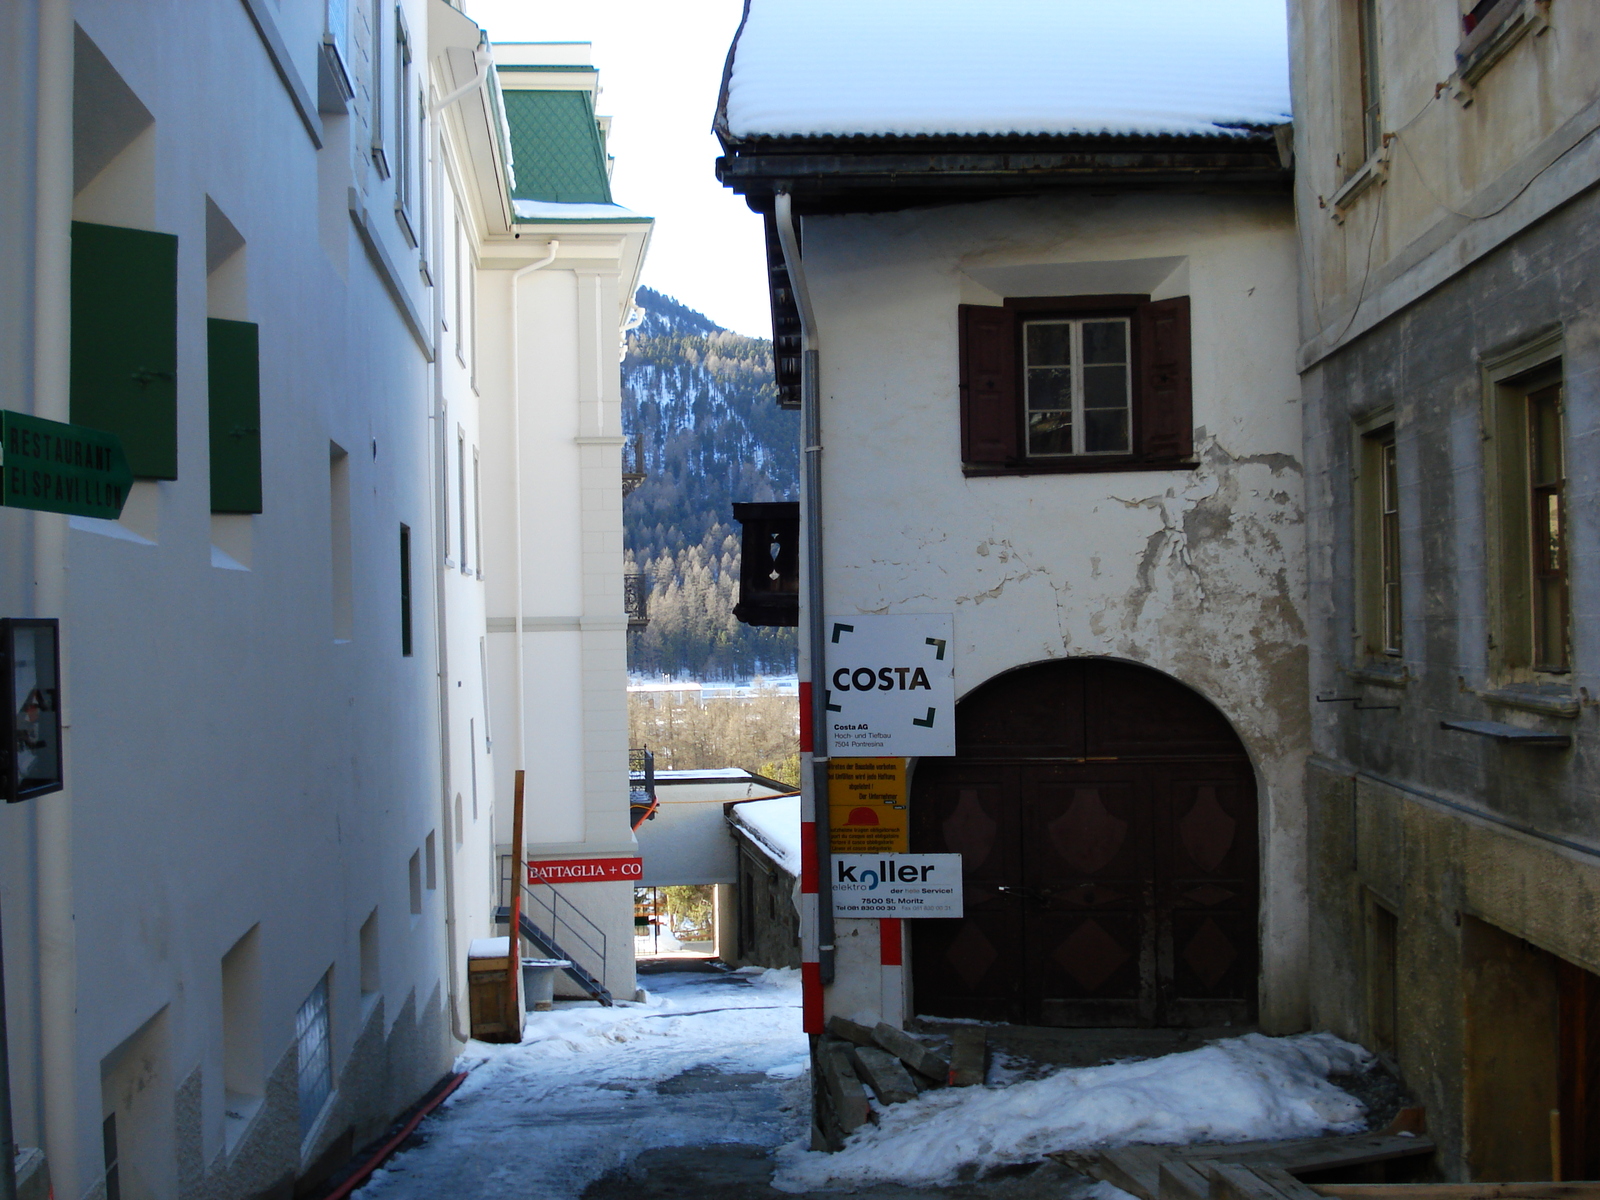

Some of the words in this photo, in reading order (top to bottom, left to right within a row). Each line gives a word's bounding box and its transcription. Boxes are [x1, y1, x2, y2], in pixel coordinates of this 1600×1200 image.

[10, 427, 112, 472] RESTAURANT
[832, 667, 932, 692] COSTA
[834, 723, 856, 731] Costa
[857, 723, 869, 731] AG
[530, 865, 606, 879] BATTAGLIA
[621, 863, 642, 875] CO
[838, 860, 935, 891] koller
